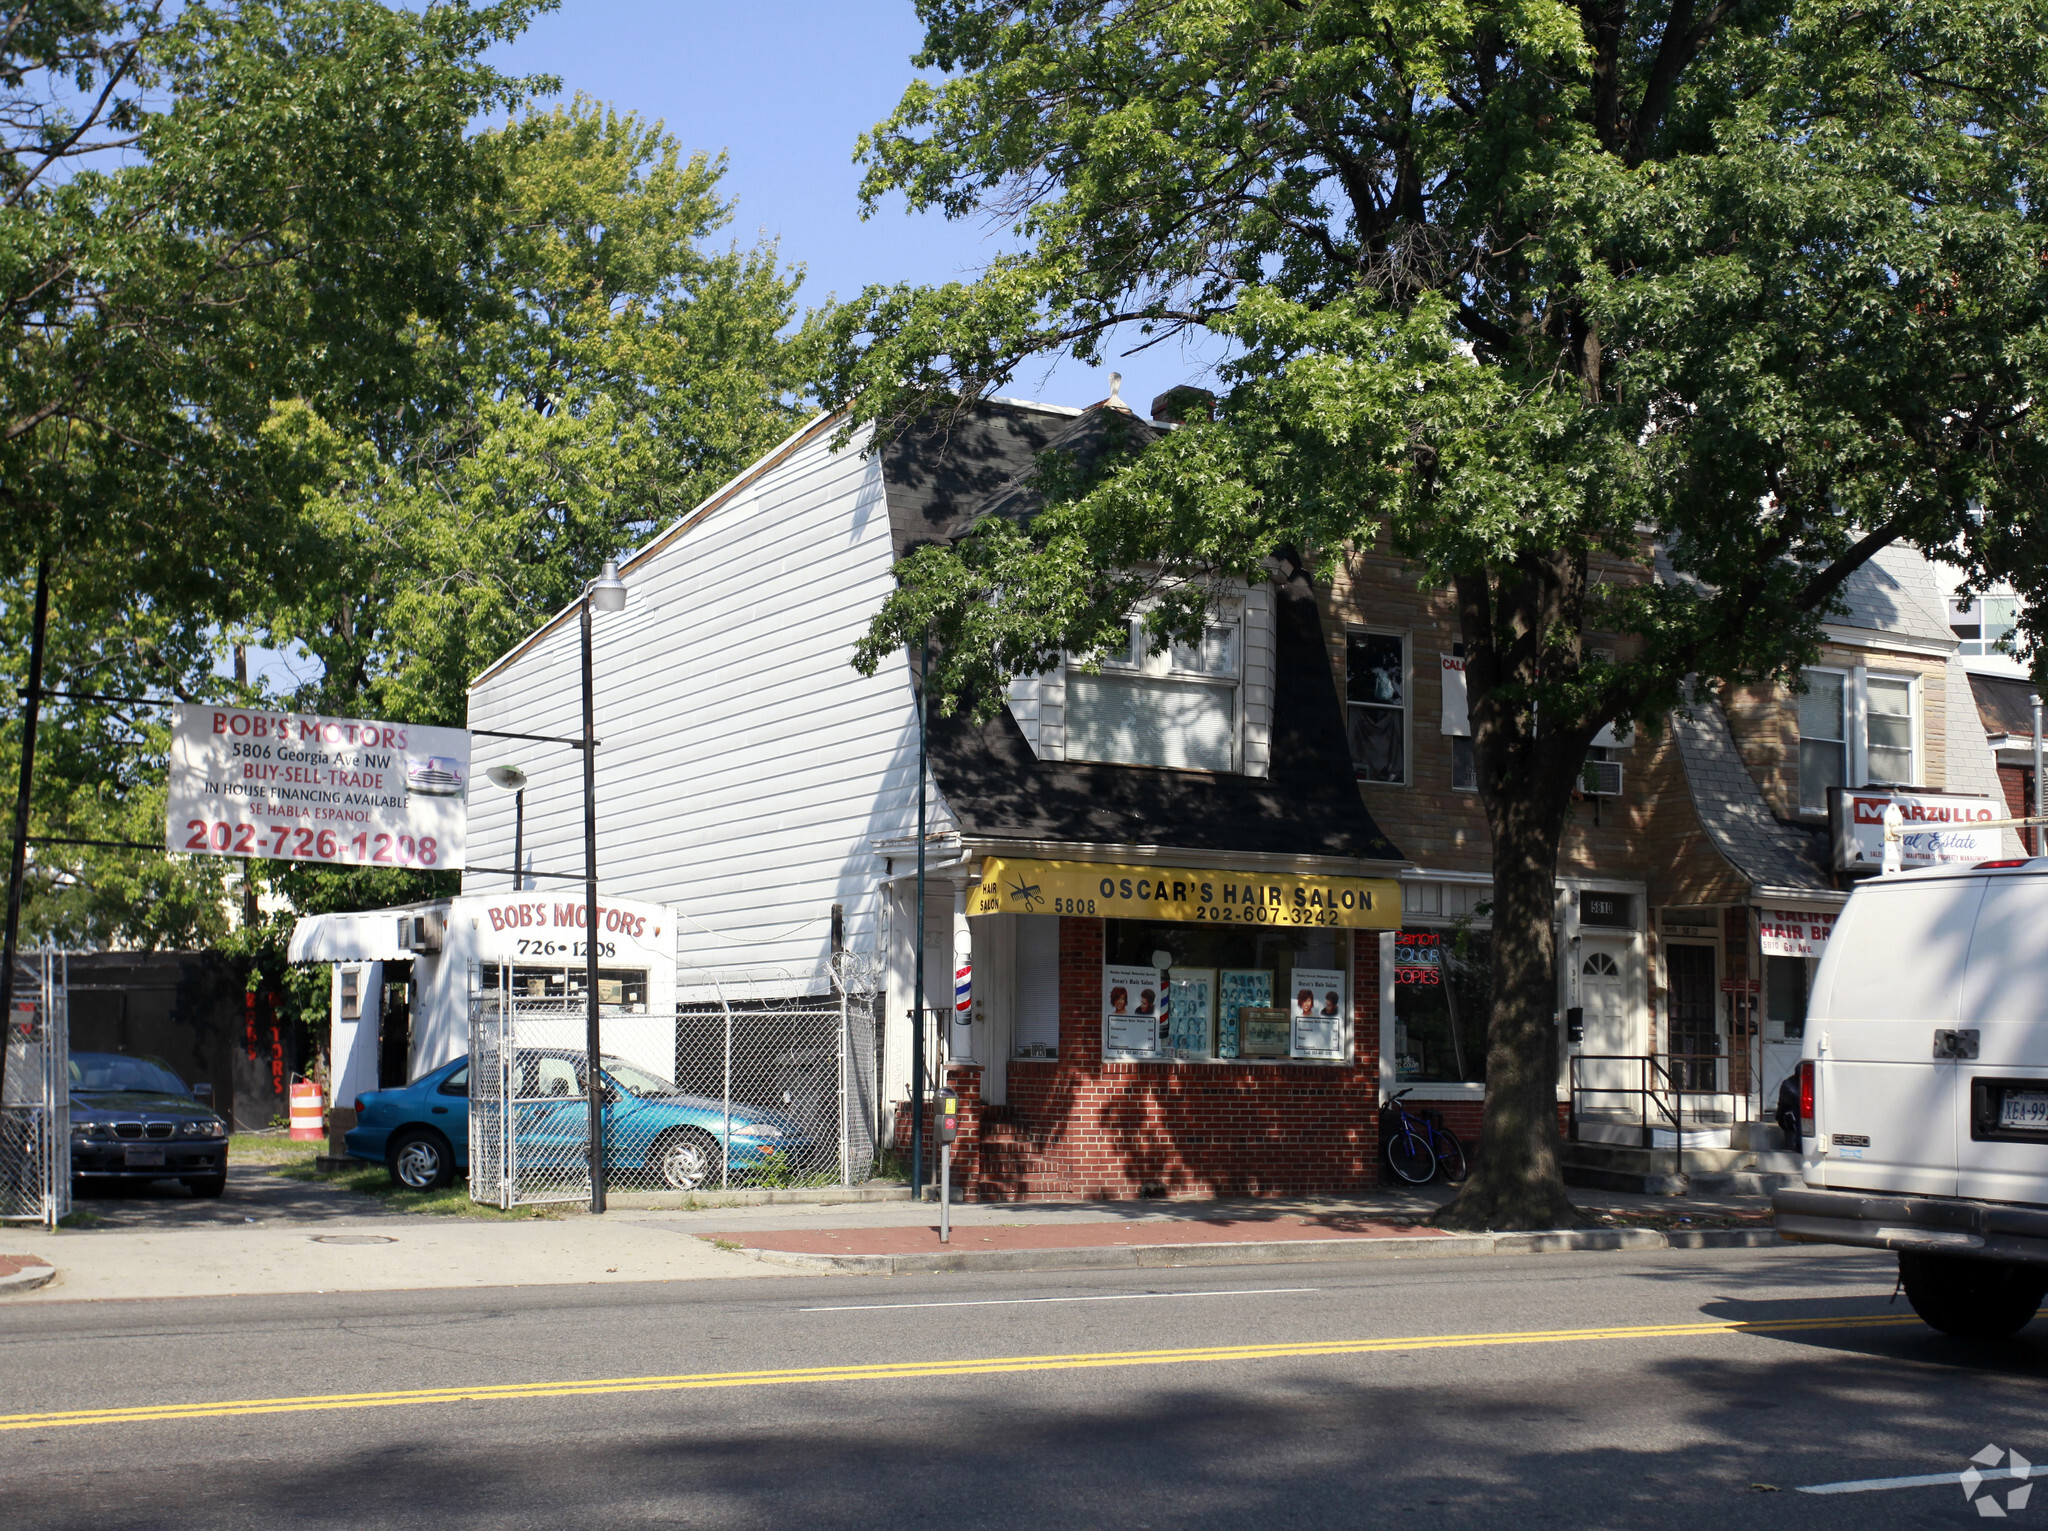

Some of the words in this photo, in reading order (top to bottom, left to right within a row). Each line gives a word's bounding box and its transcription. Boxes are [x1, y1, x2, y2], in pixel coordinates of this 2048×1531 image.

[213, 712, 290, 740] BOB'S
[300, 720, 409, 750] MOTORS
[232, 743, 272, 759] 5806
[277, 747, 329, 766] Georgia
[333, 752, 360, 767] Ave
[365, 754, 391, 769] NW
[243, 763, 384, 790] BUY-SELL-TRADE
[205, 782, 219, 795] IN
[224, 783, 266, 798] HOUSE
[271, 786, 341, 804] FINANCING
[344, 793, 410, 810] AVAILABLE
[249, 803, 264, 815] SE
[267, 805, 310, 819] HABLA
[315, 807, 371, 823] ESPANOL
[1859, 803, 1993, 823] MARZULLO
[185, 820, 438, 866] 202-726-1208
[1928, 832, 1977, 851] Estate
[982, 882, 997, 895] HAIR
[1100, 878, 1213, 904] OSCAR'S
[1224, 884, 1282, 906] HAIR
[1294, 887, 1373, 911] SALON
[980, 898, 1000, 911] SALON
[1055, 898, 1096, 915] 5808
[1591, 901, 1613, 914] 5810
[488, 902, 547, 932] BOB'S
[554, 902, 647, 938] MOTORS
[1197, 906, 1339, 926] 202-607-3242
[1395, 931, 1440, 945] Canon
[1761, 922, 1805, 940] HAIR
[1763, 942, 1780, 950] 5810
[268, 991, 284, 1095] MTORS
